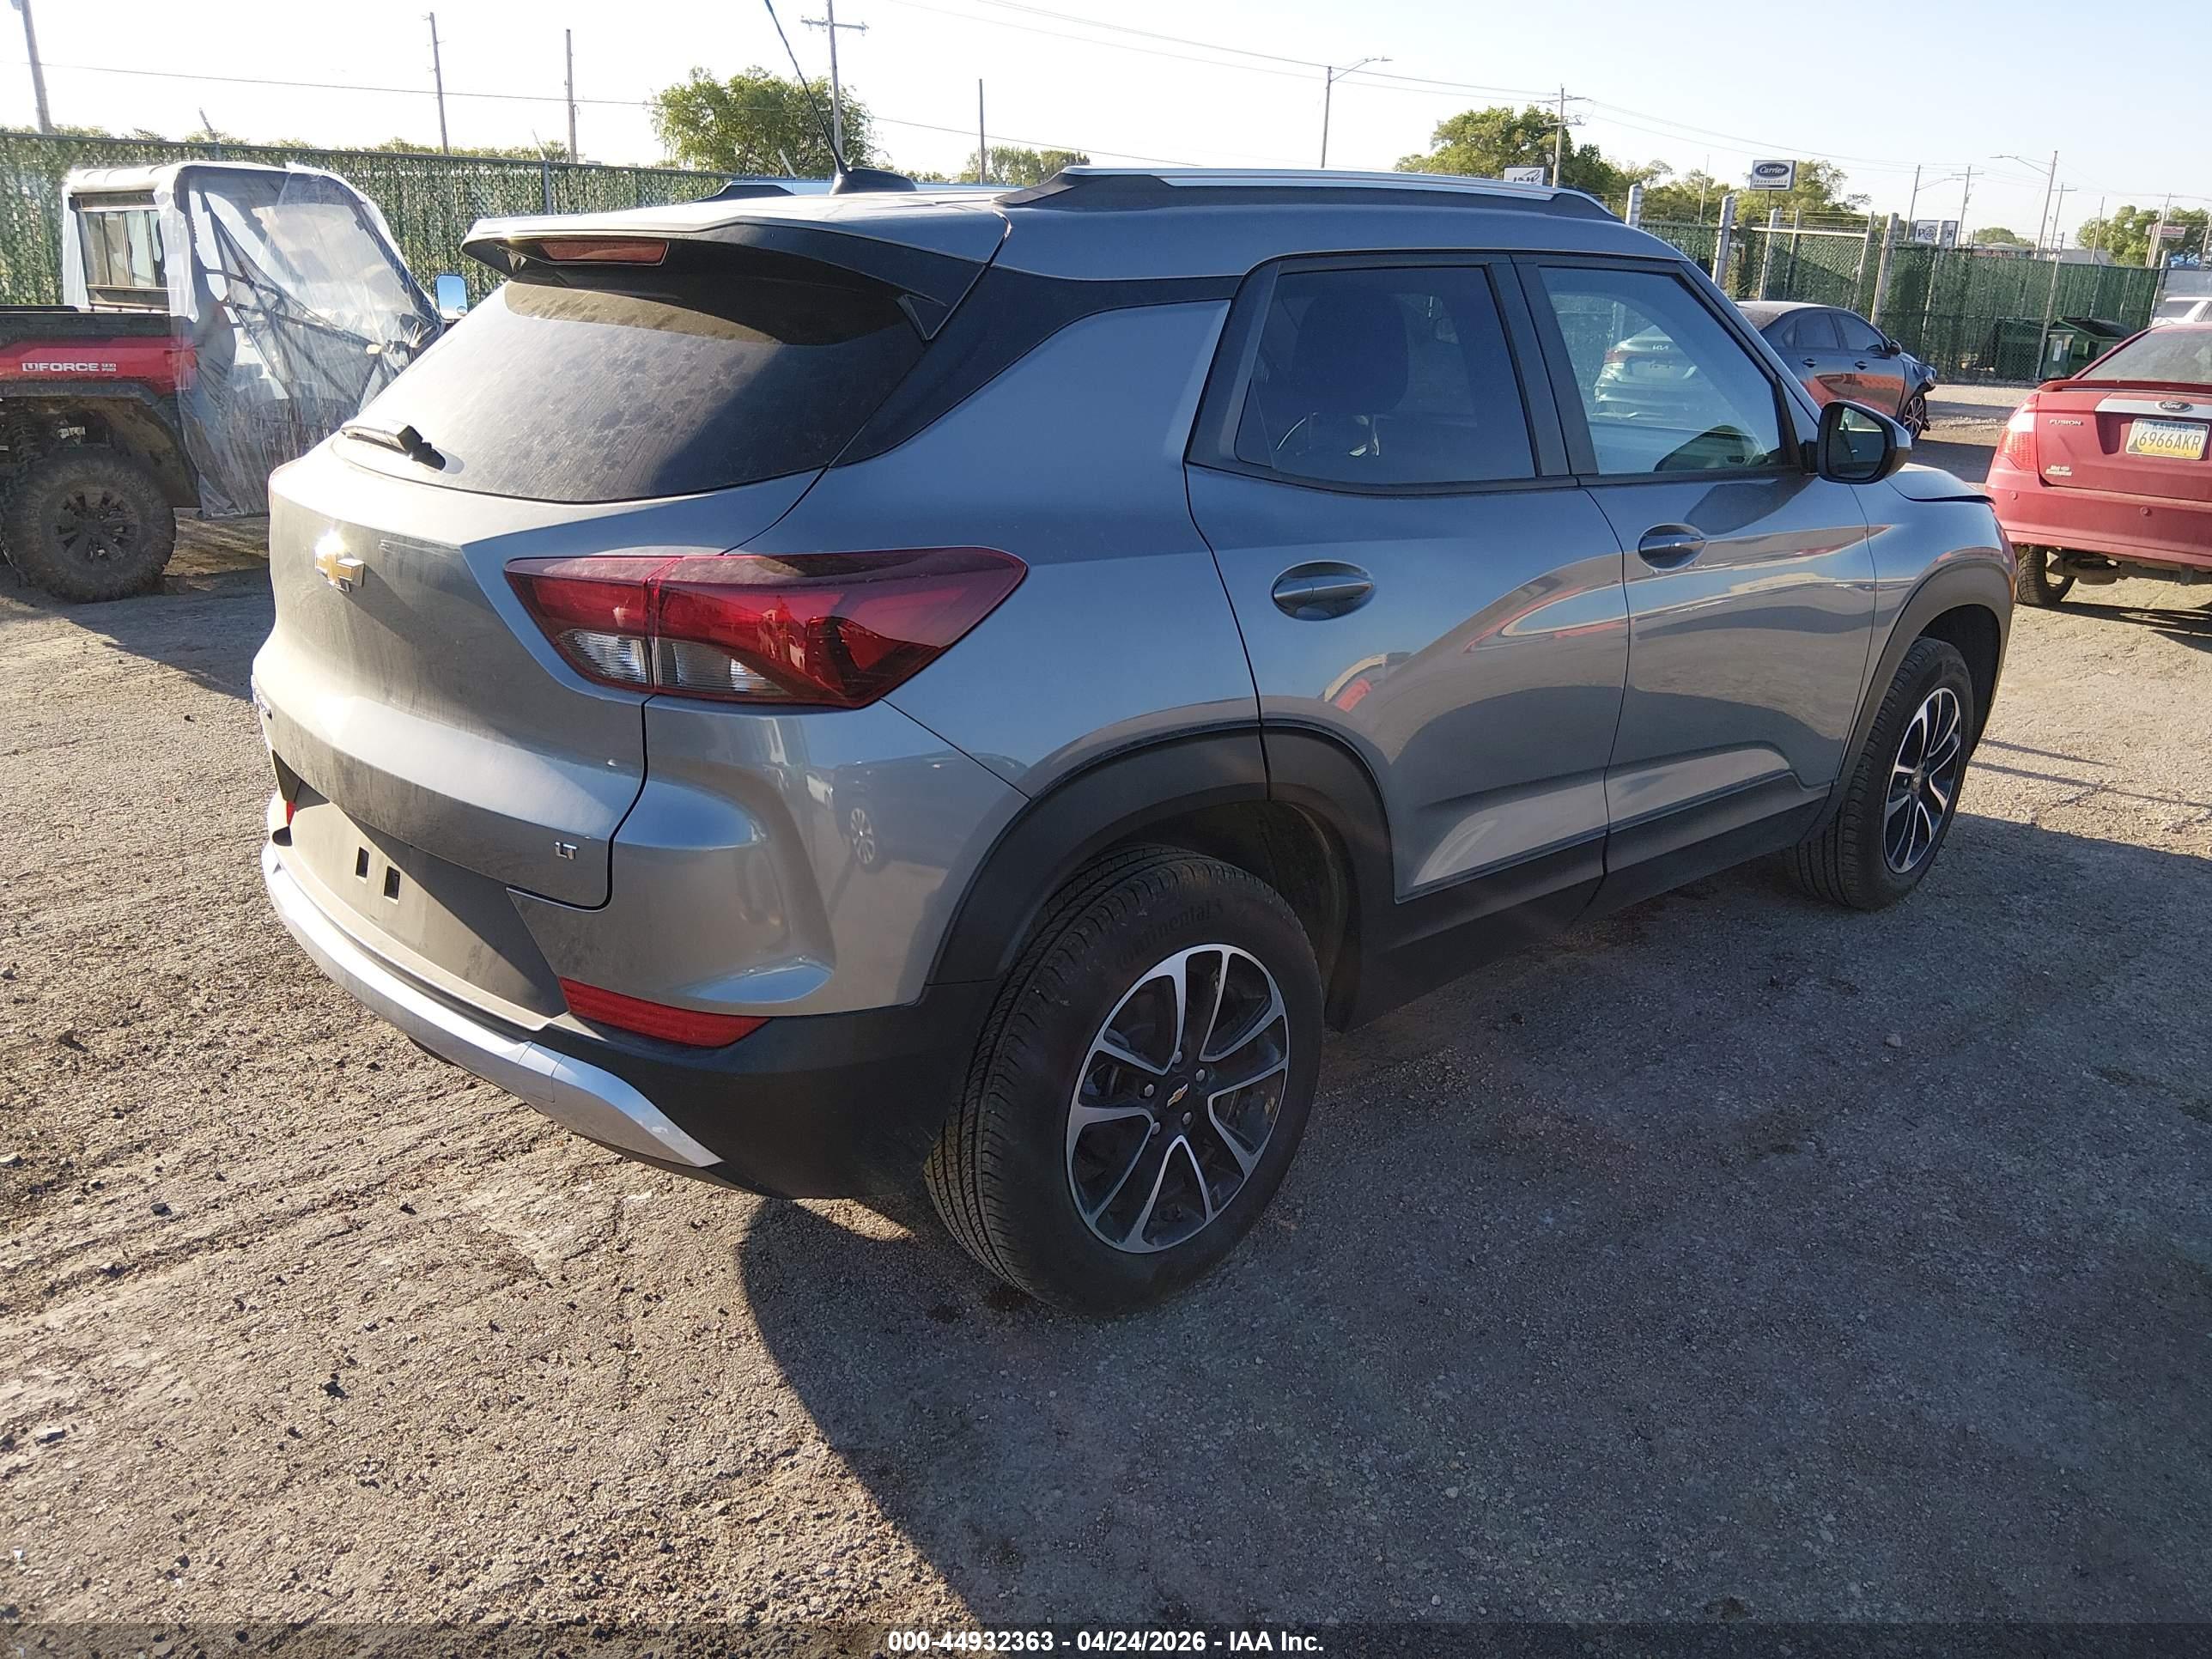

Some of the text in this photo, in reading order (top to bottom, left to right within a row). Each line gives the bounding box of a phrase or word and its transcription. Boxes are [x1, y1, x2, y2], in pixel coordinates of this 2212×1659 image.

[2162, 401, 2182, 410] Ford
[2152, 422, 2189, 433] KANSAS
[2139, 431, 2202, 452] 6966AKR
[555, 841, 577, 860] LT
